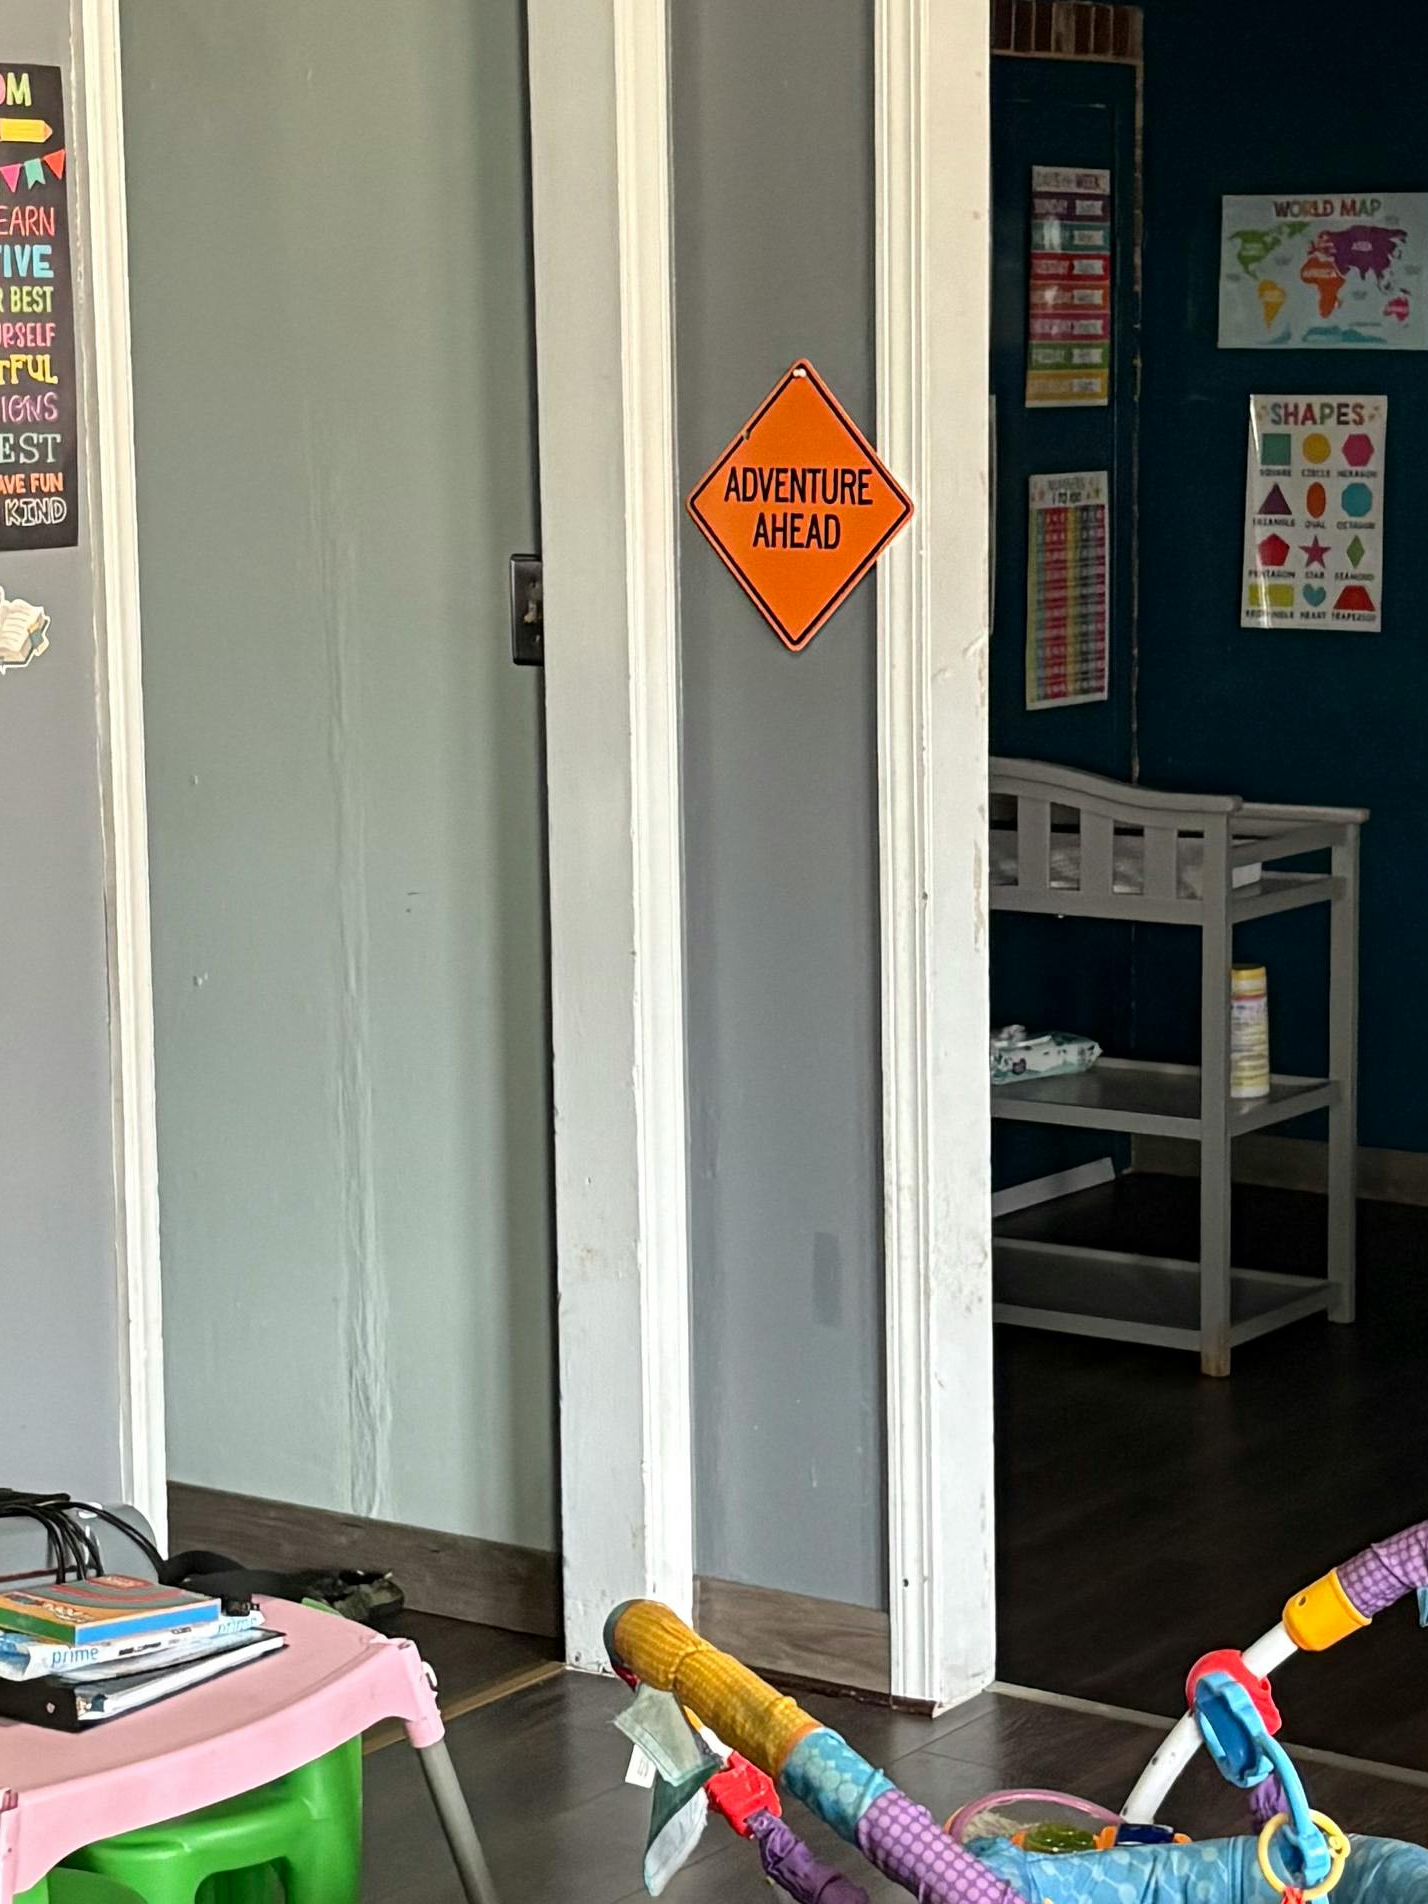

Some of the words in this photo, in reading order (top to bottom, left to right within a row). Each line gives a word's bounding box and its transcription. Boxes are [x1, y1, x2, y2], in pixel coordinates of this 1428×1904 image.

[1274, 200, 1334, 217] WORLD
[1340, 199, 1381, 217] MAP
[10, 285, 54, 313] BEST
[1271, 403, 1365, 426] SHAPES
[30, 472, 63, 493] FUN
[724, 466, 872, 506] ADVENTURE
[6, 497, 67, 526] KIND
[752, 512, 841, 550] AHEAD
[51, 1646, 99, 1668] prime
